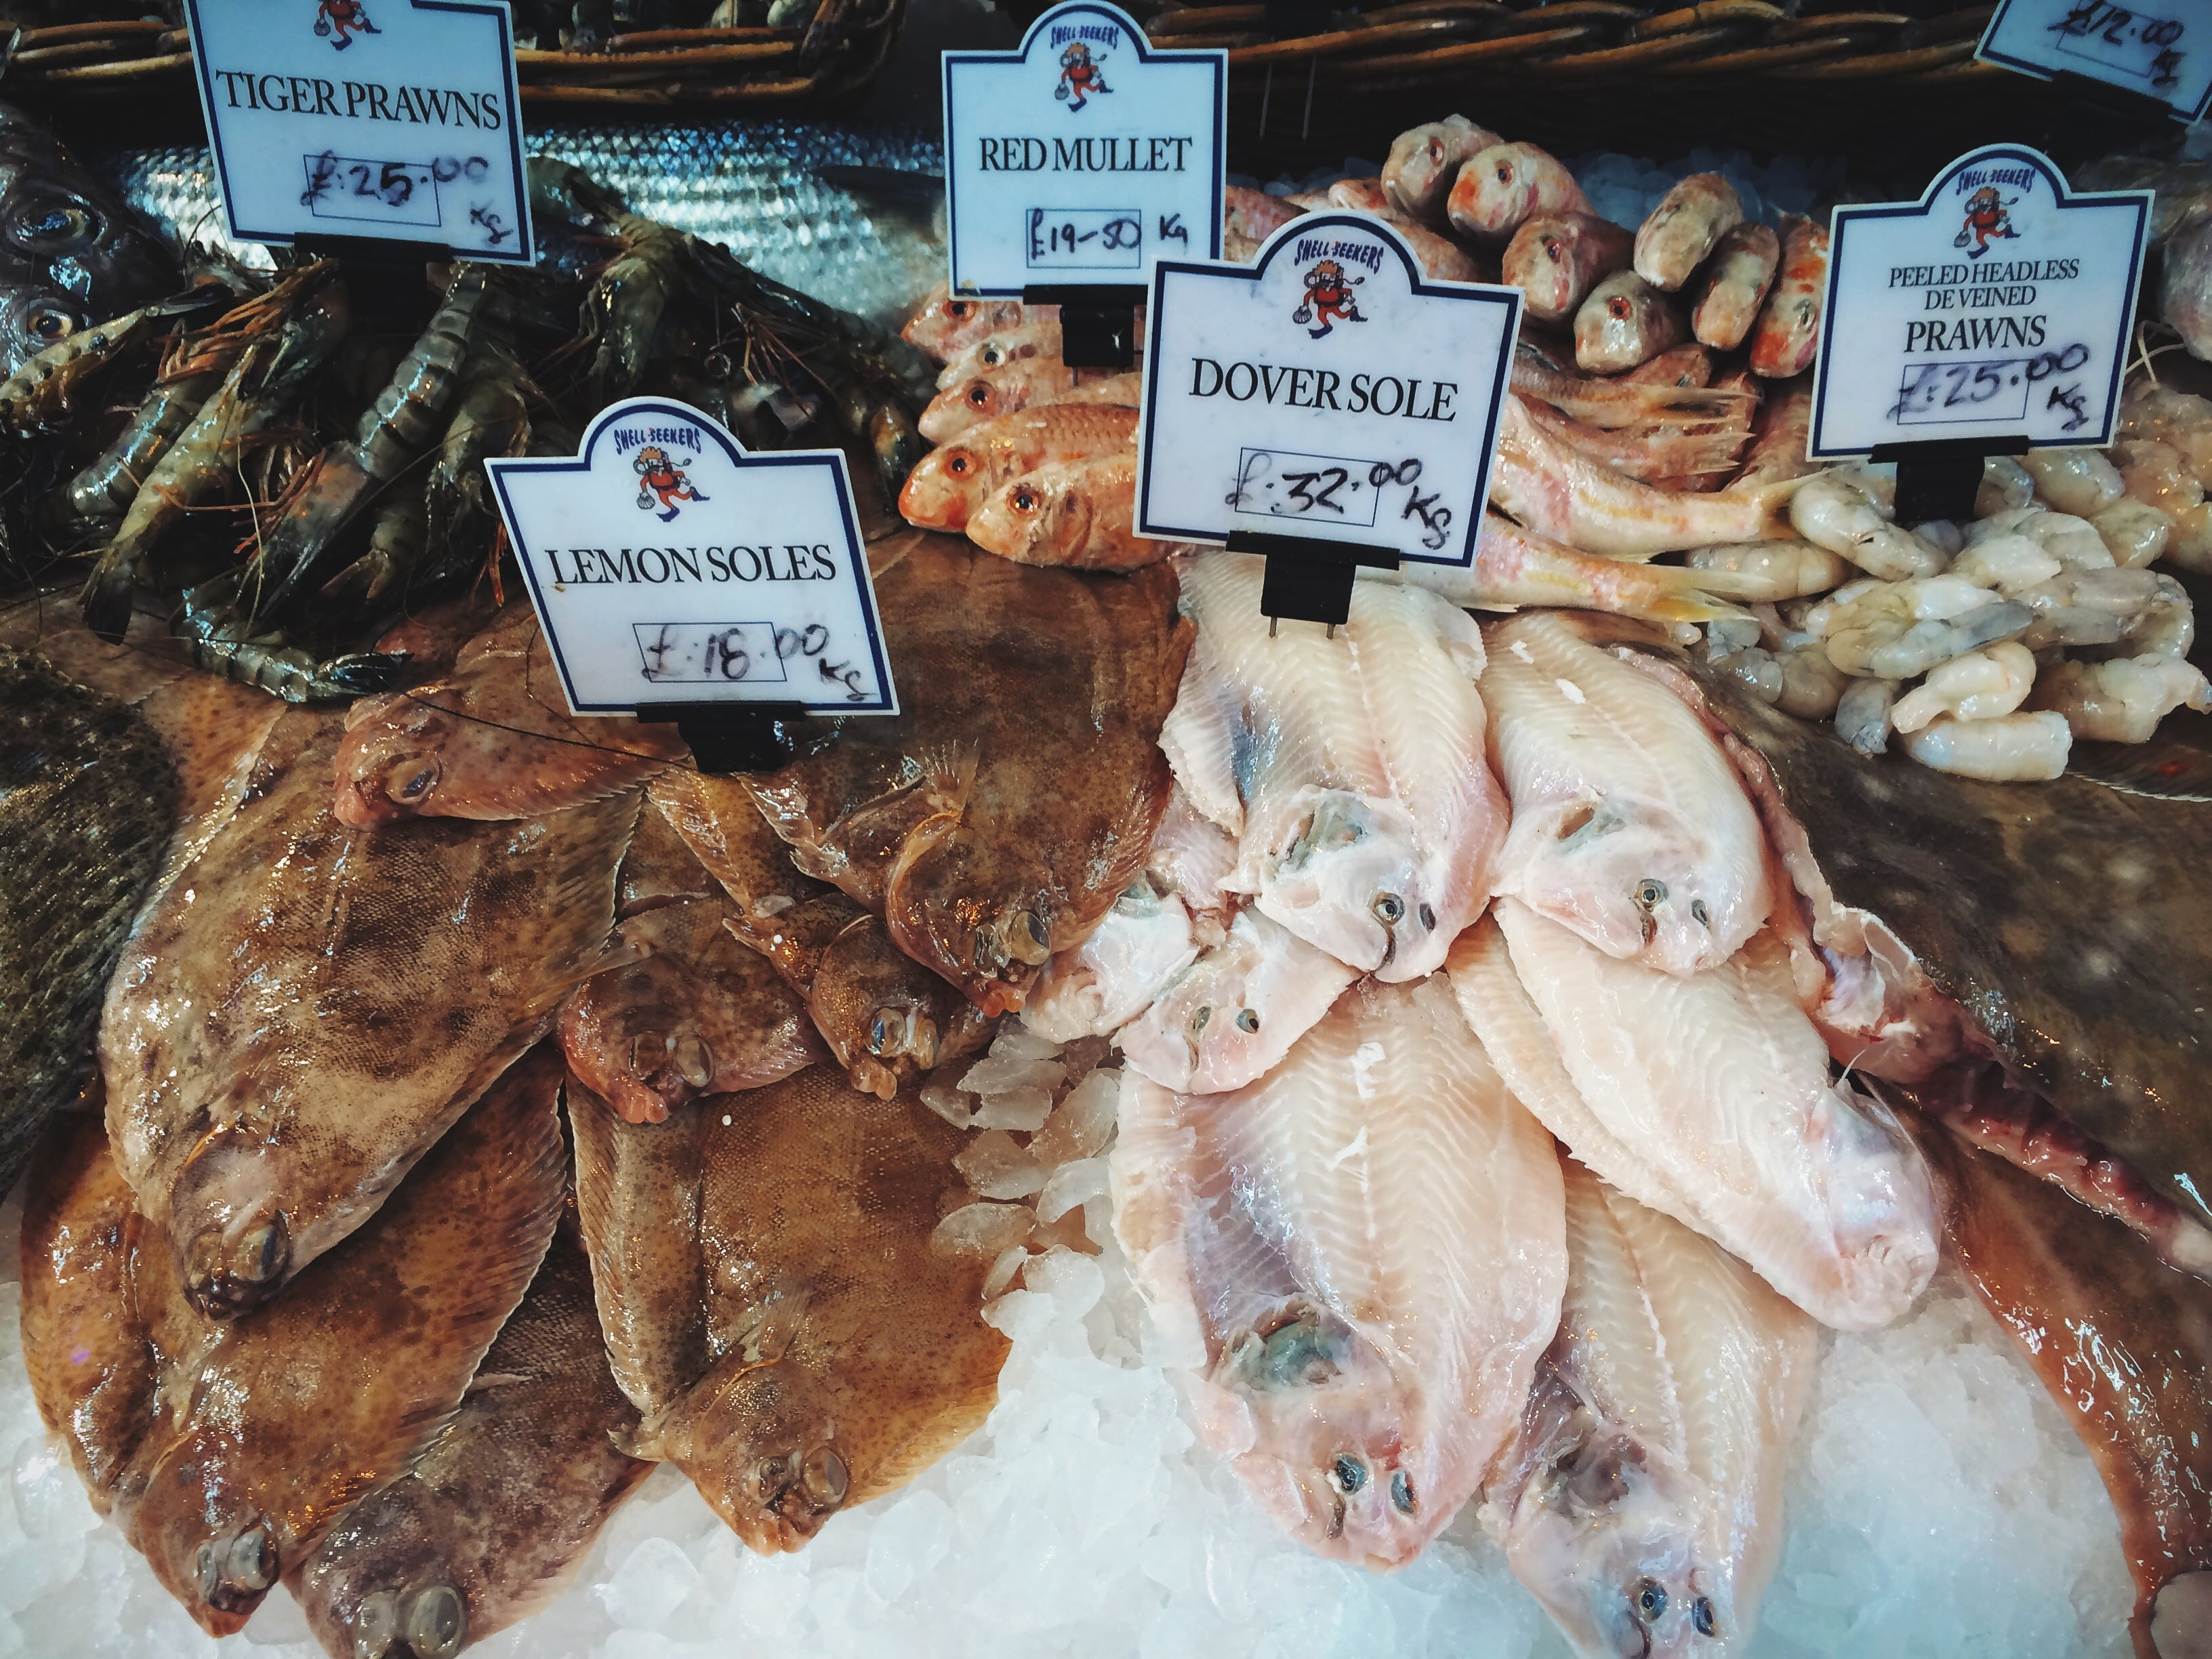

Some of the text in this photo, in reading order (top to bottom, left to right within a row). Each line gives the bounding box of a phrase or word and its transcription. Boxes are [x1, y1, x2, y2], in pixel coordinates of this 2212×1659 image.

[1050, 26, 1120, 49] SHELL SEEKERS
[216, 69, 501, 130] TIGER PRAWNS
[979, 137, 1192, 171] RED MULLET
[1956, 167, 2036, 196] SHELL SEEKERS
[1294, 238, 1384, 274] SHELL SEEKERS
[1889, 258, 2080, 287] PEELED HEADLESS
[1925, 285, 2036, 310] DE VEINED
[1904, 315, 2047, 353] PRAWNS
[1189, 358, 1458, 422] DOVER SOLE
[614, 427, 701, 455] SHELL SEEKERS
[545, 544, 836, 584] LEMON SOLES
